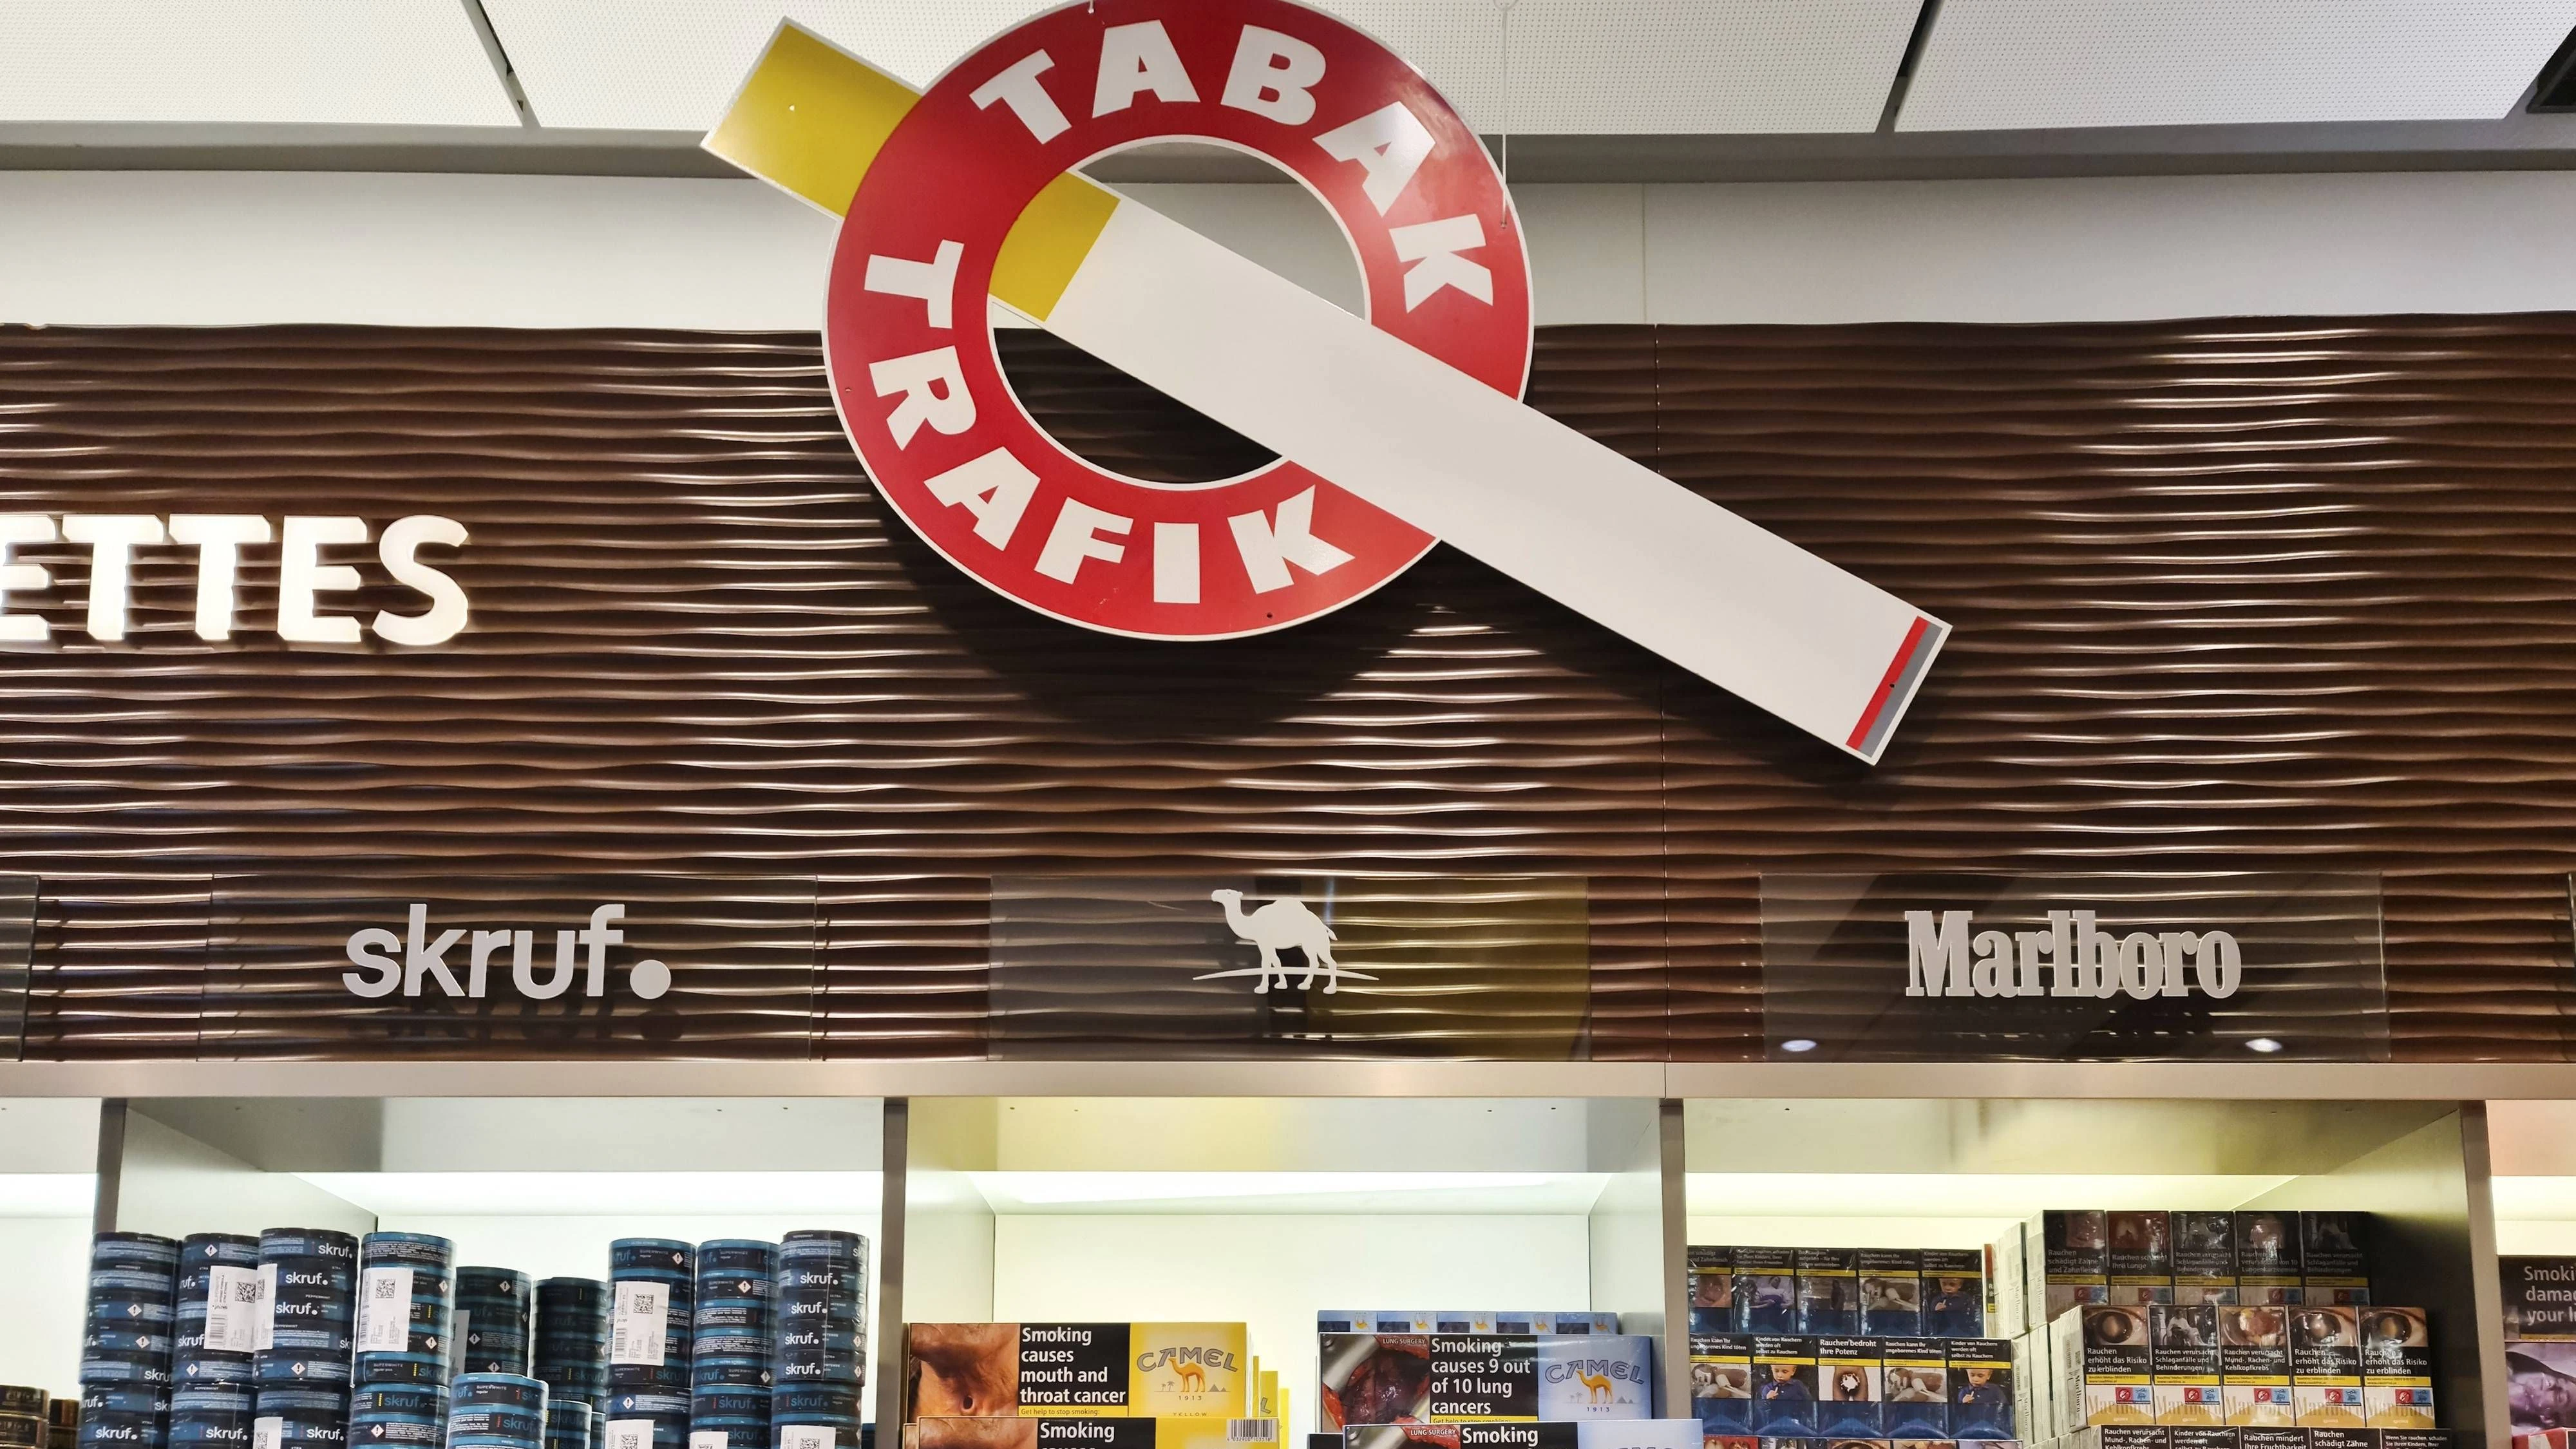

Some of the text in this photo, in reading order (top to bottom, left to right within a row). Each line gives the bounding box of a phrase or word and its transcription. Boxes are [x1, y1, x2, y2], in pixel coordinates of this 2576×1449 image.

[969, 19, 1493, 314] TABAK
[864, 240, 1354, 603] TRAFIK
[0, 515, 468, 645] ETTES
[343, 904, 671, 999] skruf.
[1904, 910, 2241, 999] Marlboro
[318, 1243, 352, 1259] skruf.
[285, 1272, 328, 1285] skruf.
[800, 1272, 838, 1285] skruf.
[2524, 1265, 2576, 1281] Smoki
[276, 1302, 317, 1315] skruf.
[791, 1302, 828, 1314] skruf.
[2526, 1310, 2564, 1326] your
[784, 1332, 819, 1345] skruf.
[1022, 1326, 1092, 1346] Smoking
[1431, 1338, 1501, 1357] Smoking
[1021, 1350, 1074, 1362] causes
[1137, 1347, 1238, 1372] CAMEL
[785, 1363, 821, 1375] skruf.
[1431, 1359, 1530, 1374] causes 9 out
[1545, 1359, 1644, 1385] CAMEL
[1021, 1367, 1108, 1383] mouth and
[1020, 1387, 1126, 1403] throat cancer
[1431, 1378, 1512, 1397] of 10 lung
[1431, 1402, 1492, 1414] cancers
[95, 1426, 137, 1441] skruf.
[205, 1427, 247, 1441] skruf.
[307, 1426, 344, 1441] skruf.
[1040, 1421, 1115, 1443] Smoking
[1463, 1426, 1538, 1446] Smoking
[2315, 1439, 2345, 1448] schädigt
